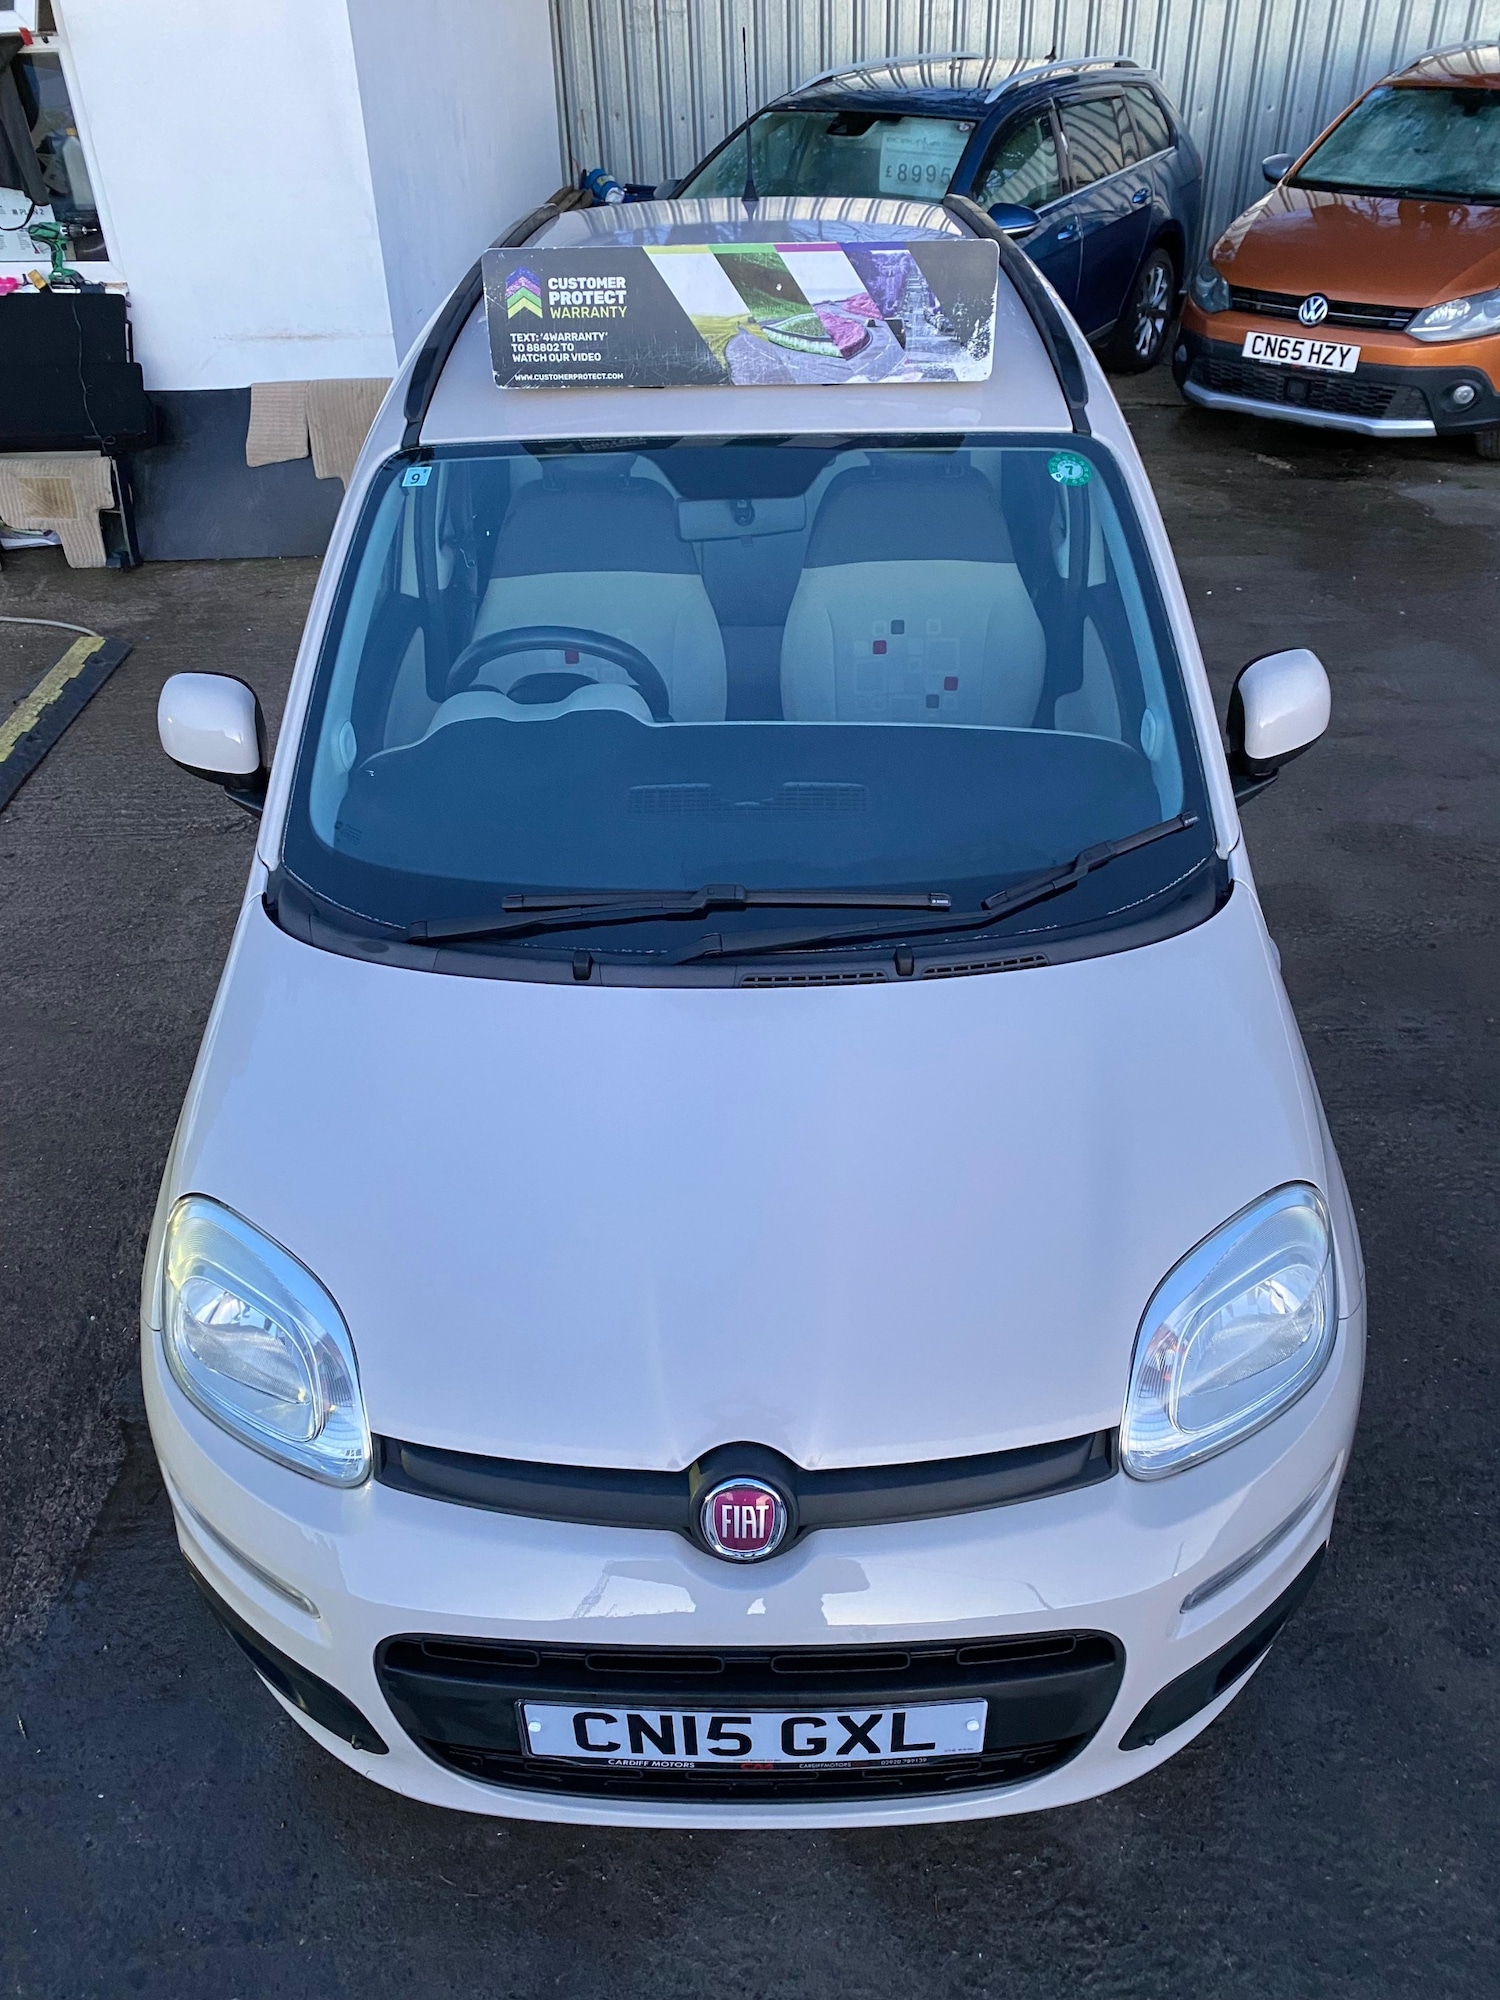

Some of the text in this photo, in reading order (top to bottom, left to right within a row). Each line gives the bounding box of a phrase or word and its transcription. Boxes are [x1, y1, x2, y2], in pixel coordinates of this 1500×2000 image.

[547, 276, 627, 290] CUSTOMER
[548, 290, 627, 305] PROTECT
[550, 305, 628, 319] WARRANTY
[510, 333, 540, 343] TEXT:
[511, 342, 575, 352] TO 88802 TO
[1251, 335, 1352, 368] CN65 HZY
[512, 352, 602, 363] WATCH OUR VIDEO
[514, 373, 624, 381] WWW.CUSTOMERPROTECT.COM
[1064, 465, 1074, 476] 7
[721, 1504, 770, 1539] FIAT
[572, 1711, 936, 1757] CN15 GXL
[608, 1759, 649, 1767] CARDIFF
